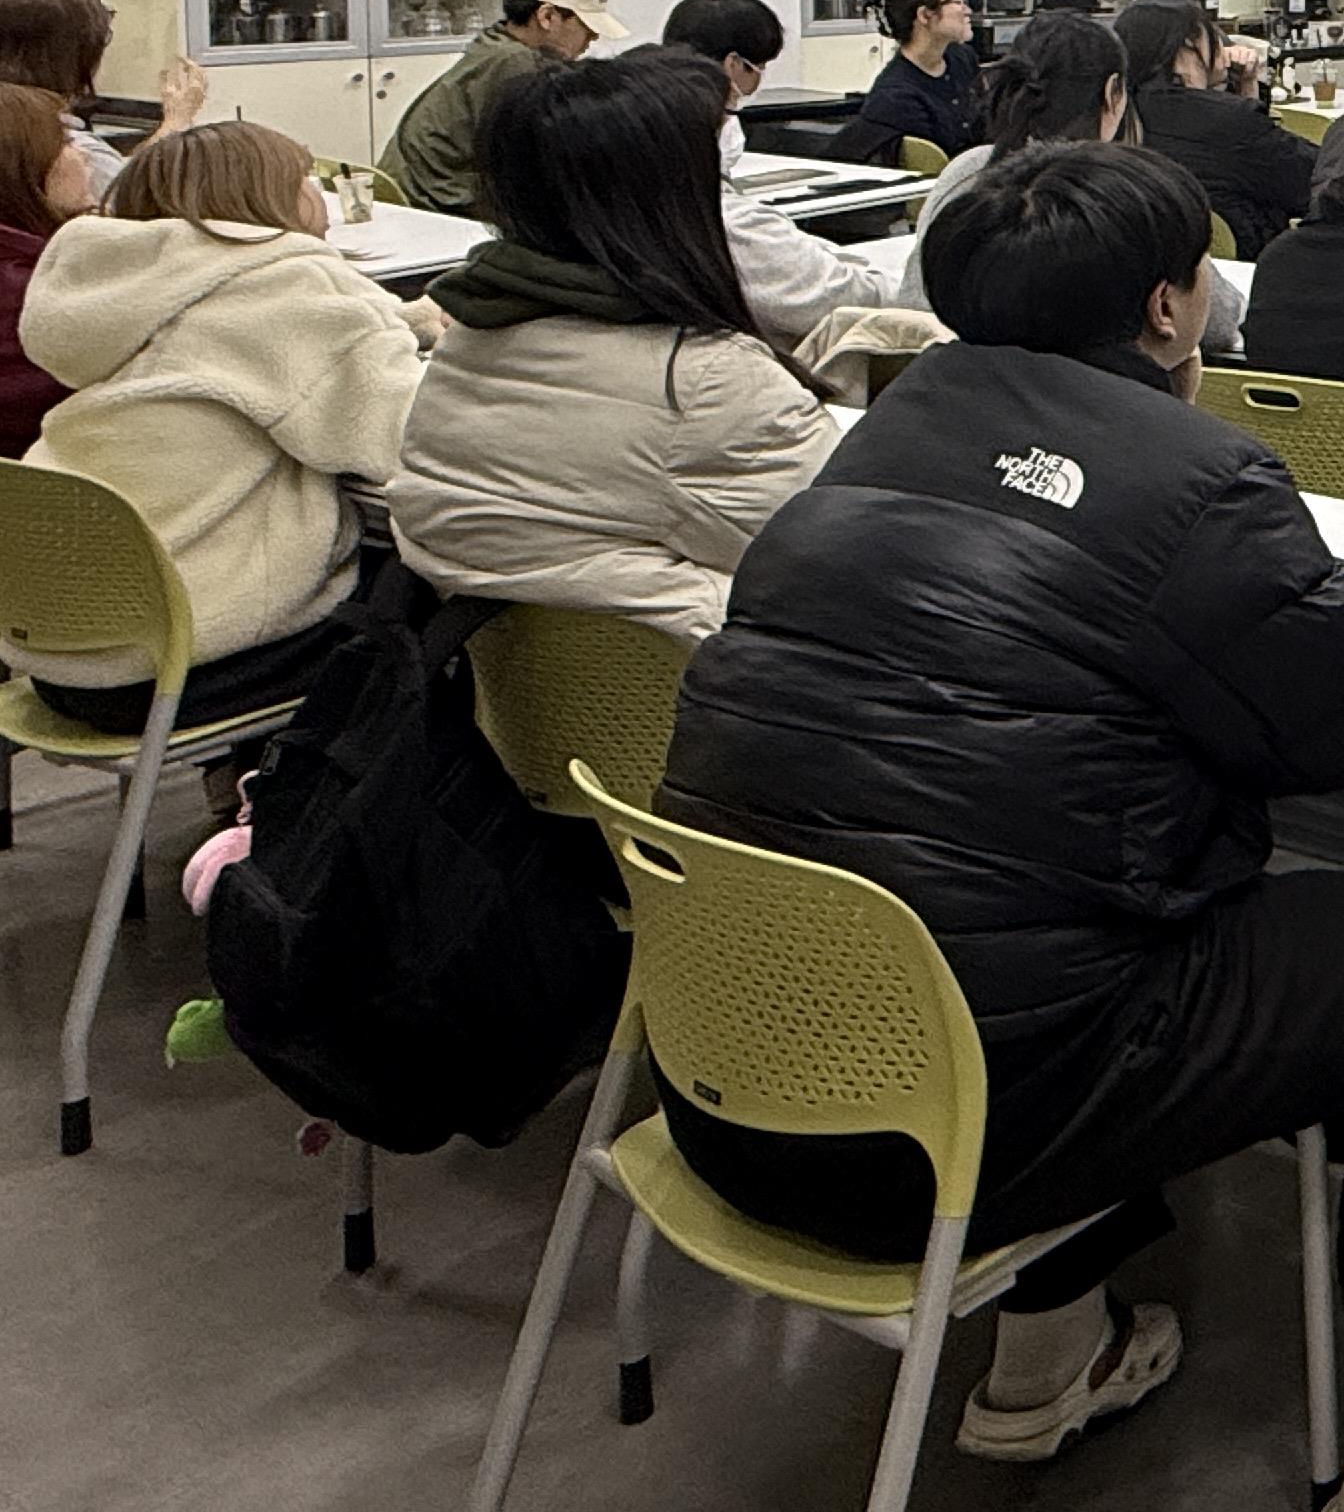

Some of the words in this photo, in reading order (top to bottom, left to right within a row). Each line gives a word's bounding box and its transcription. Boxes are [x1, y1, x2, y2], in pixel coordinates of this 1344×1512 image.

[994, 454, 1056, 489] NORTH
[1028, 446, 1064, 472] THE
[1000, 472, 1048, 497] FACE
